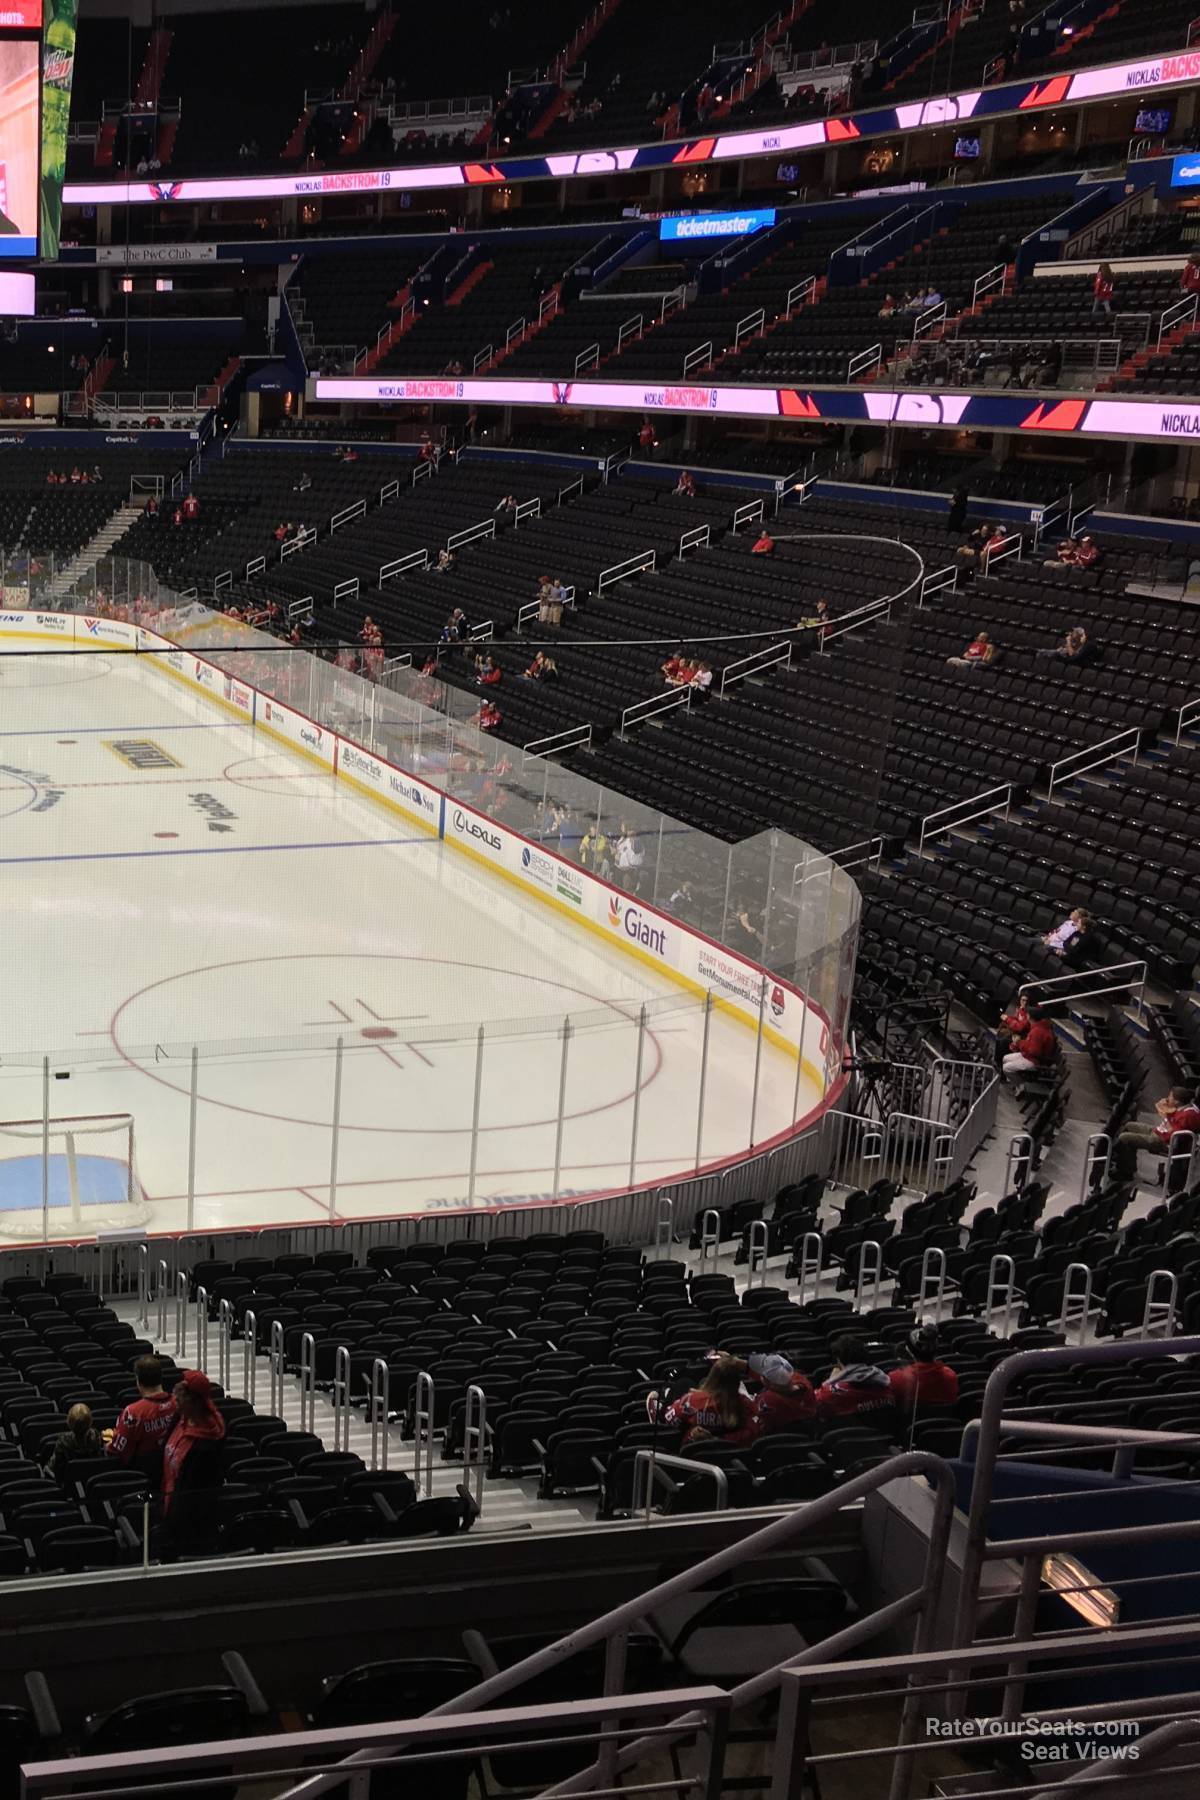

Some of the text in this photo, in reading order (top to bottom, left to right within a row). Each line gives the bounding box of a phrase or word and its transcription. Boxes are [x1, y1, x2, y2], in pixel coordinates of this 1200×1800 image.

[1126, 67, 1160, 87] NICKLAS
[294, 172, 391, 192] NICKLAS BACKSTROM 19
[677, 217, 751, 236] ticketmaster
[121, 249, 191, 261] The PwC Club
[378, 381, 464, 398] NICKLAS BACKSTROM 19
[644, 387, 718, 408] NICKLAS BACKSTROM 19
[389, 775, 412, 798] Michael
[422, 796, 434, 813] Son
[465, 819, 502, 850] LEXUS
[624, 907, 667, 956] Giant
[698, 950, 718, 968] START
[717, 958, 734, 977] YOUR
[733, 968, 751, 986] FREE
[113, 1433, 128, 1452] 19
